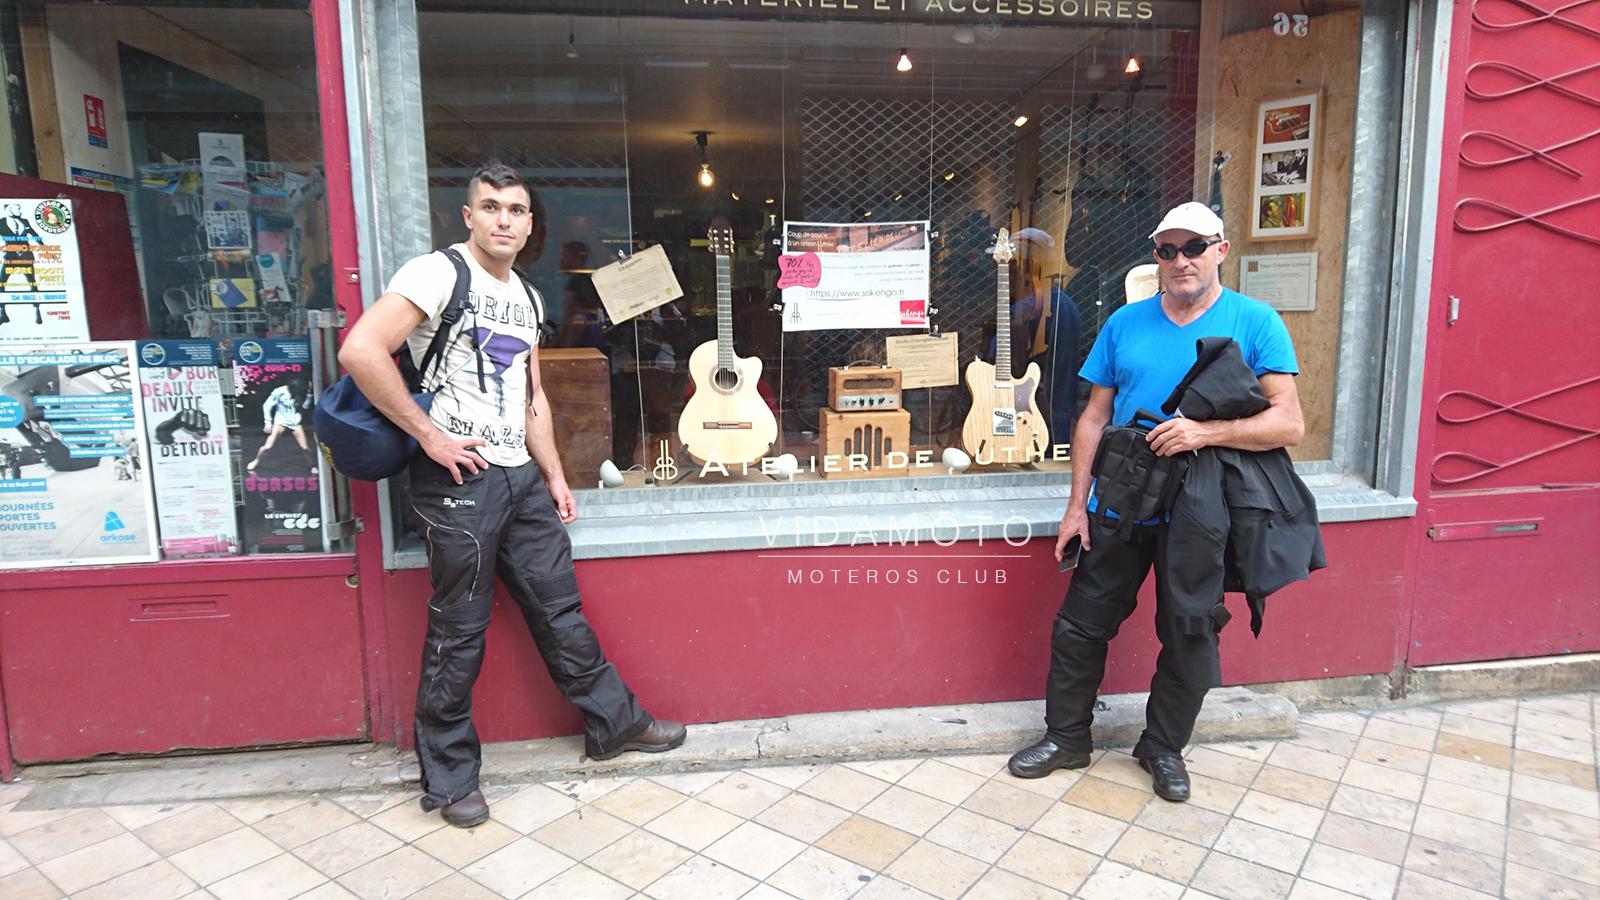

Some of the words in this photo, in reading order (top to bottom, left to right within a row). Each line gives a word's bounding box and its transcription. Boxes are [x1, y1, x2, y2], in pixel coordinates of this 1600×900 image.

[873, 0, 906, 11] ET
[925, 0, 1153, 19] ACCESSOIRES
[17, 355, 78, 365] D'ESCALADE
[92, 354, 120, 363] BLOC
[186, 366, 218, 380] BUR
[140, 381, 195, 398] DEAUX
[161, 440, 223, 458] DETROIT
[888, 450, 933, 469] DE
[975, 443, 1071, 466] UTHE
[0, 502, 55, 511] OURNÉES
[0, 522, 57, 531] OUVERTES
